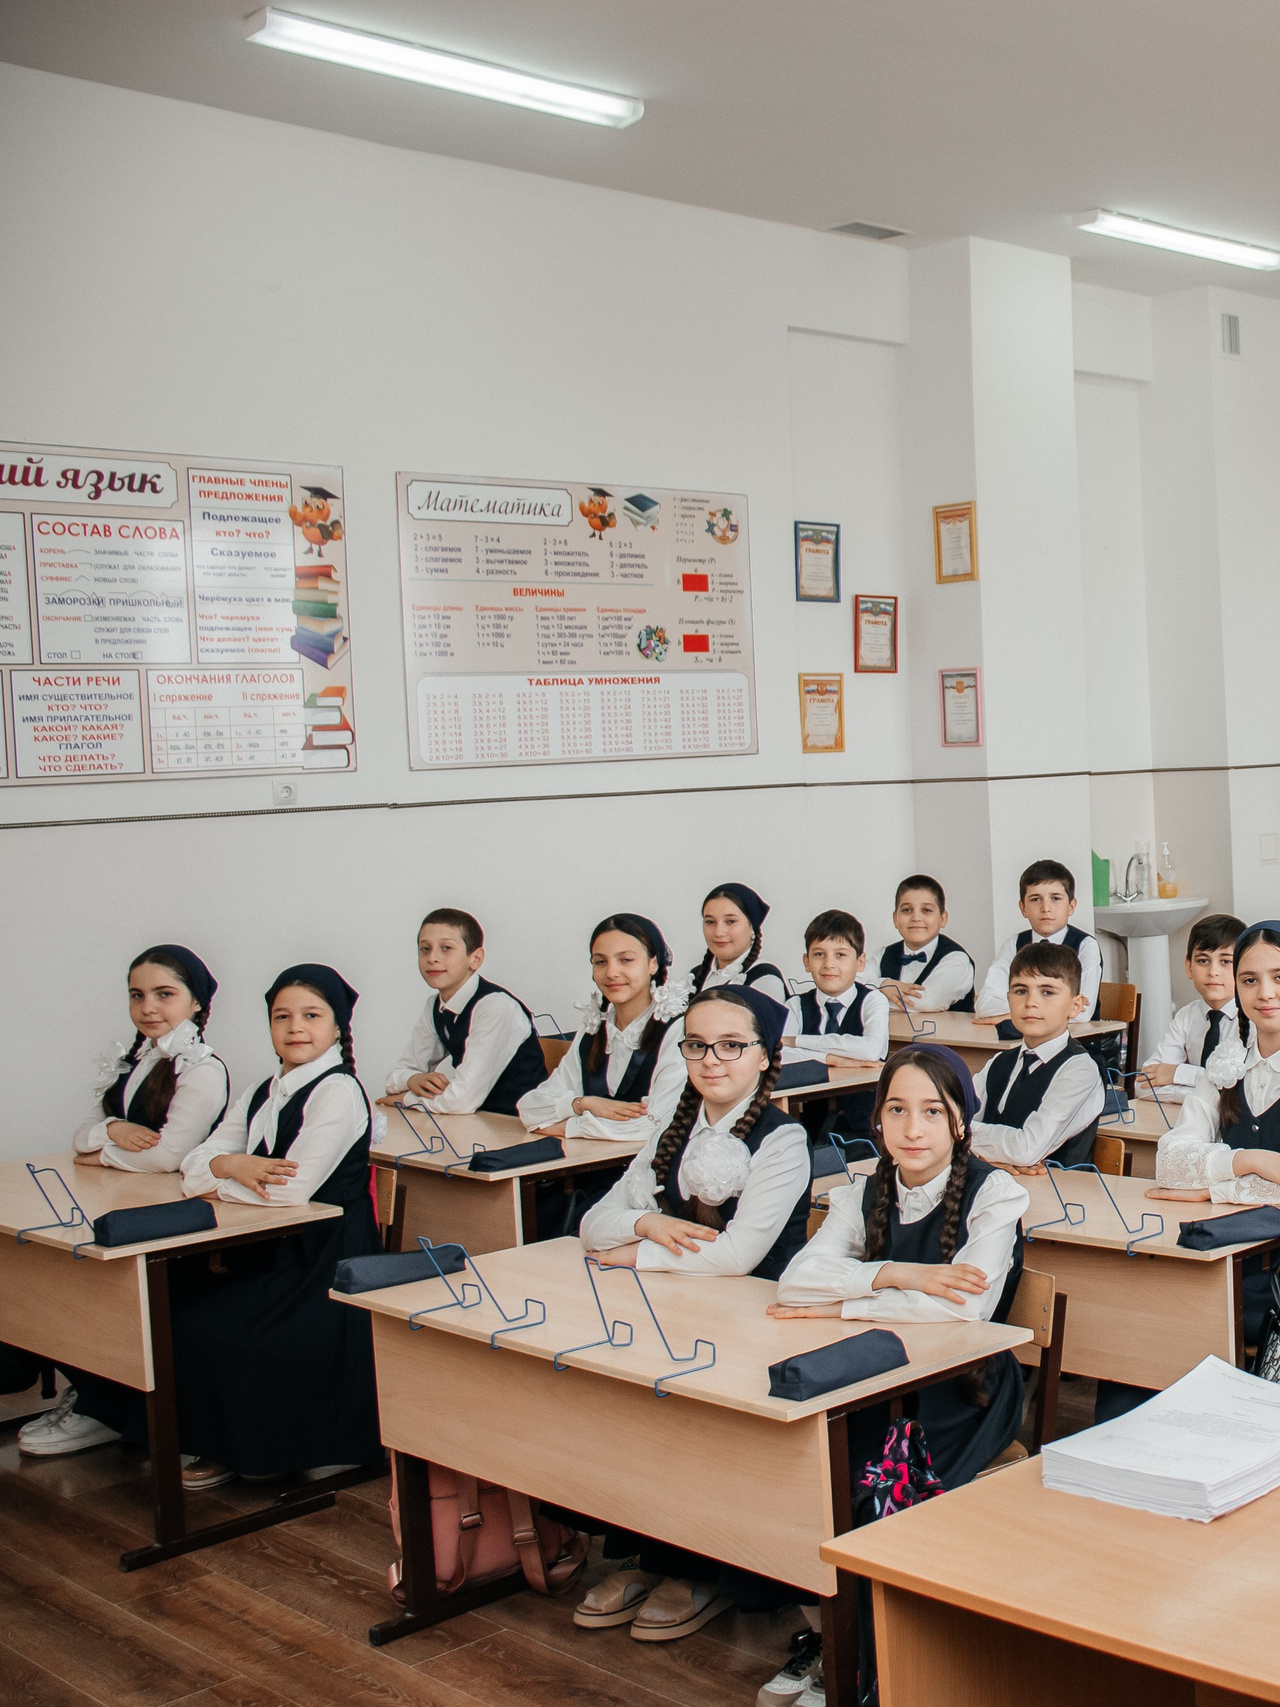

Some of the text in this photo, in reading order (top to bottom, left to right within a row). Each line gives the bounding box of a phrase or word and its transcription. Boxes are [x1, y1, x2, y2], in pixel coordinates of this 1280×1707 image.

[56, 468, 164, 500] язык
[192, 475, 289, 489] ГЛАВНЫЕ ЧЛЕНЫ
[198, 490, 284, 502] ПРЕДЛОЖЕНИЯ
[417, 490, 563, 518] Математика
[202, 511, 281, 524] Подлежащее
[37, 521, 180, 540] СОСТАВ СЛОВА
[215, 529, 271, 539] кто? что?
[211, 547, 277, 559] Сказуемое
[424, 545, 462, 553] слагаемое
[425, 556, 462, 564] слагаемое
[512, 587, 565, 597] ВЕЛИЧИНЫ
[44, 596, 104, 606] ЗАМОРОЗКИ
[32, 676, 121, 687] ЧАСТИ РЕЧИ
[156, 673, 295, 685] ОКОНЧАНИЯ ГЛАГОЛОВ
[527, 676, 661, 687] ТАБЛИЦА УМНОЖЕНИЯ
[18, 693, 134, 702] ИМЯ СУЩЕСТВИТЕЛЬНОЕ
[159, 693, 213, 704] спряжение
[251, 692, 301, 703] спряжение
[47, 703, 108, 712] КТО? ЧТО?
[46, 713, 133, 723] ПРИЛАГАТЕЛЬНОЕ
[33, 723, 124, 732] КАКОЙ? КАКАЯ?
[33, 733, 124, 742] КАКОЕ? КАКИЕ?
[59, 742, 102, 750] ГЛАГОЛ
[38, 753, 116, 763] ЧТО ДЕЛАТЬ?
[38, 762, 124, 772] ЧТО СДЕЛАТЬ?
